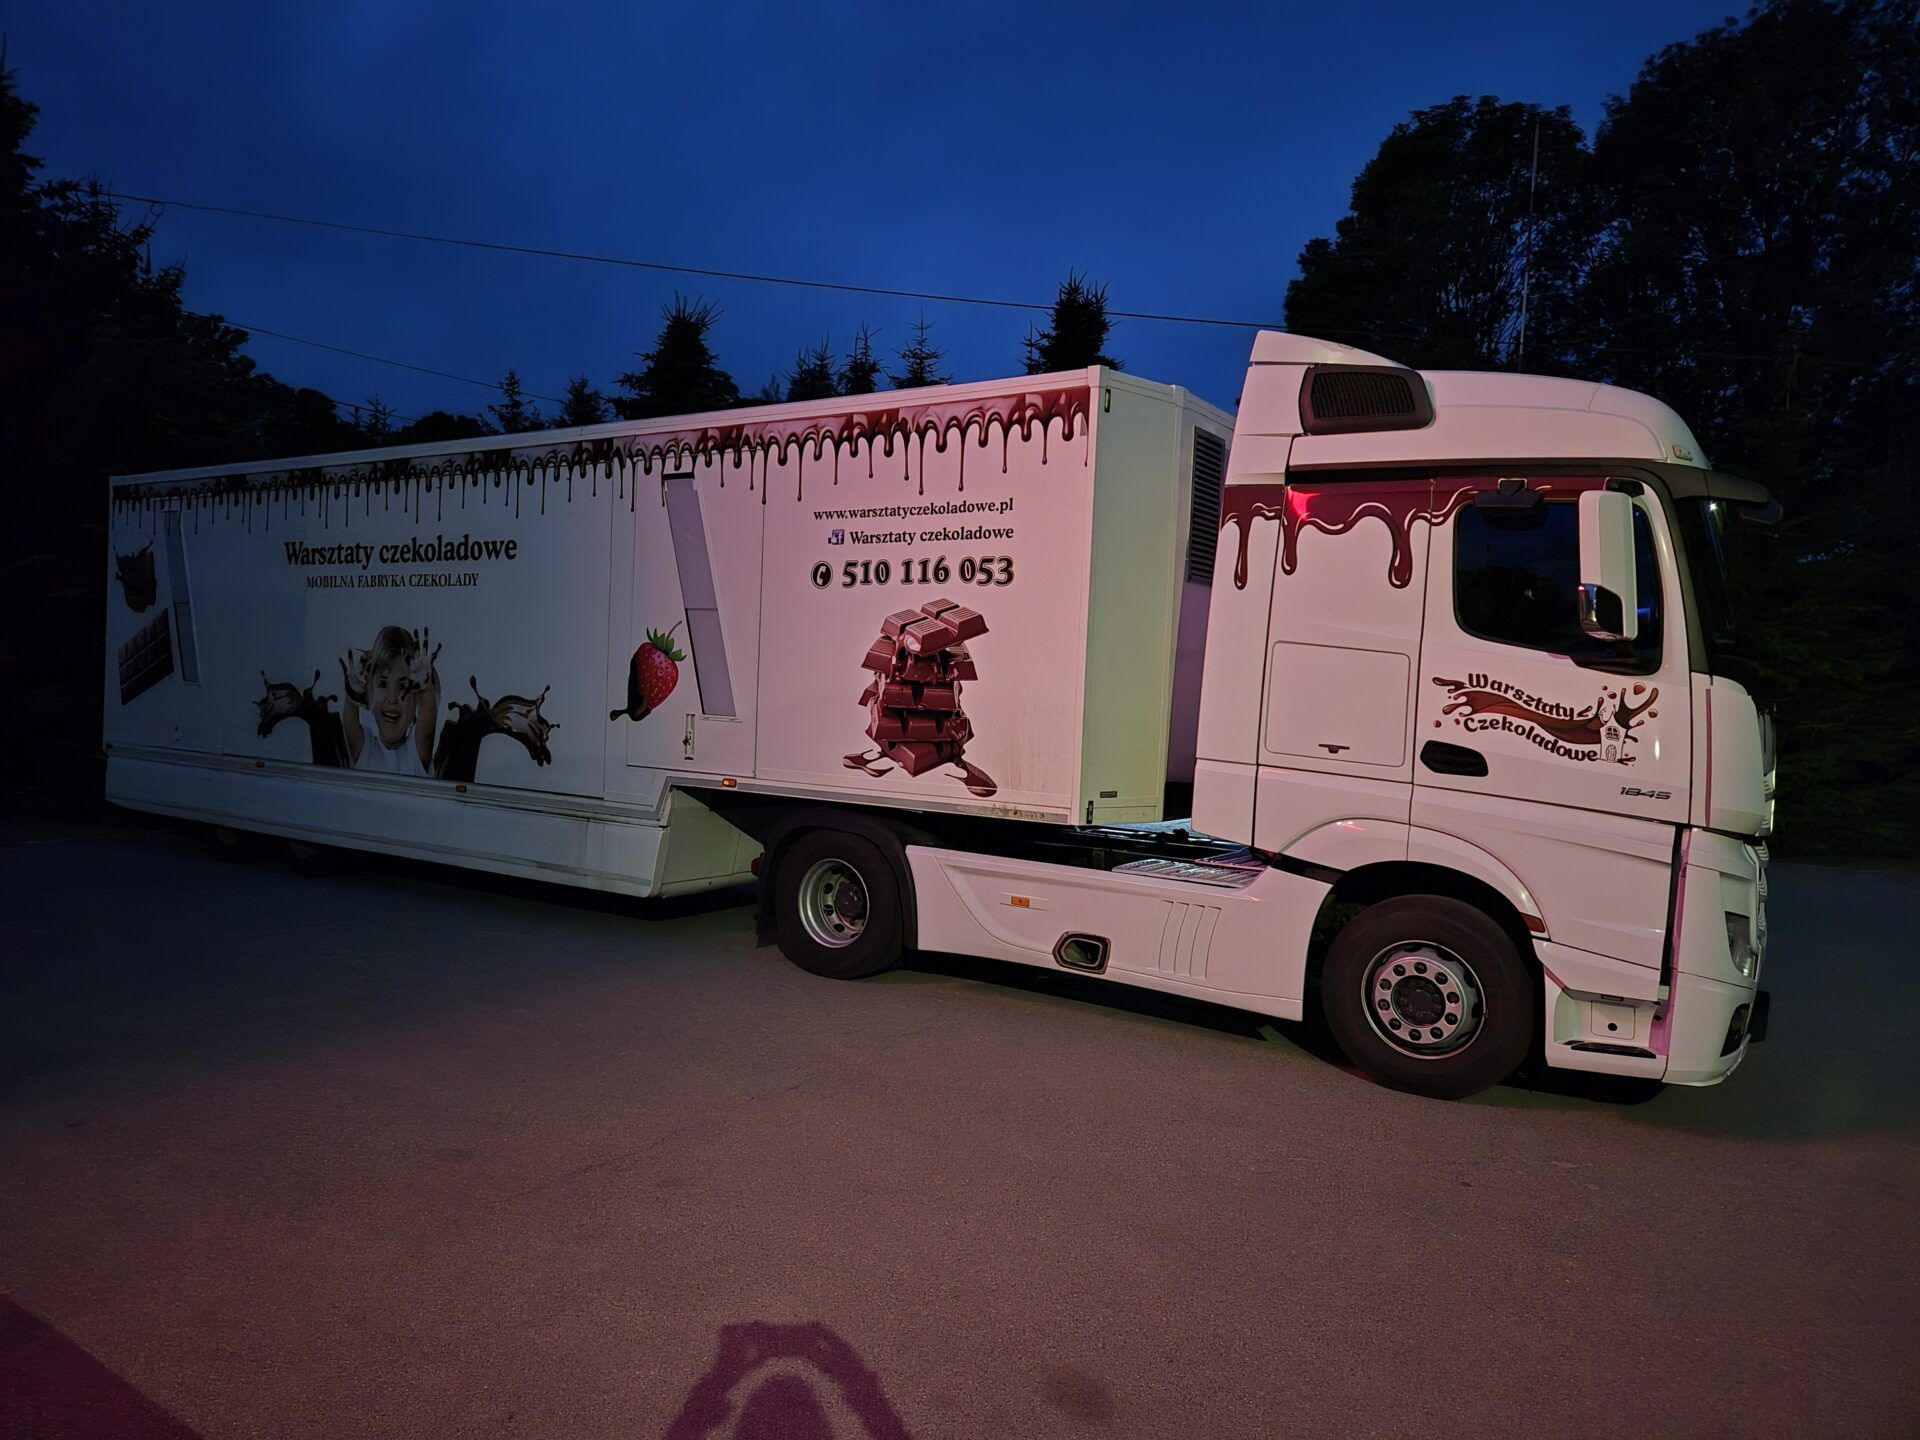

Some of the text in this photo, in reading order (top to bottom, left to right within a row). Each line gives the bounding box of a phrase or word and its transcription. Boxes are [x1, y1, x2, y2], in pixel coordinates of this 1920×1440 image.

[814, 498, 1014, 520] www.warsztatyczekoladowe.pl
[849, 526, 1014, 545] Warsztaty czekoladowe
[284, 534, 517, 570] Warsztaty czekoladowe
[306, 573, 479, 588] MOBILNA FABRYKA CZEKOLADY
[842, 555, 1014, 588] 510 116 053
[1468, 673, 1575, 721] Warsztaty
[1463, 716, 1601, 763] Czekoladowe
[1620, 787, 1672, 800] 1845
